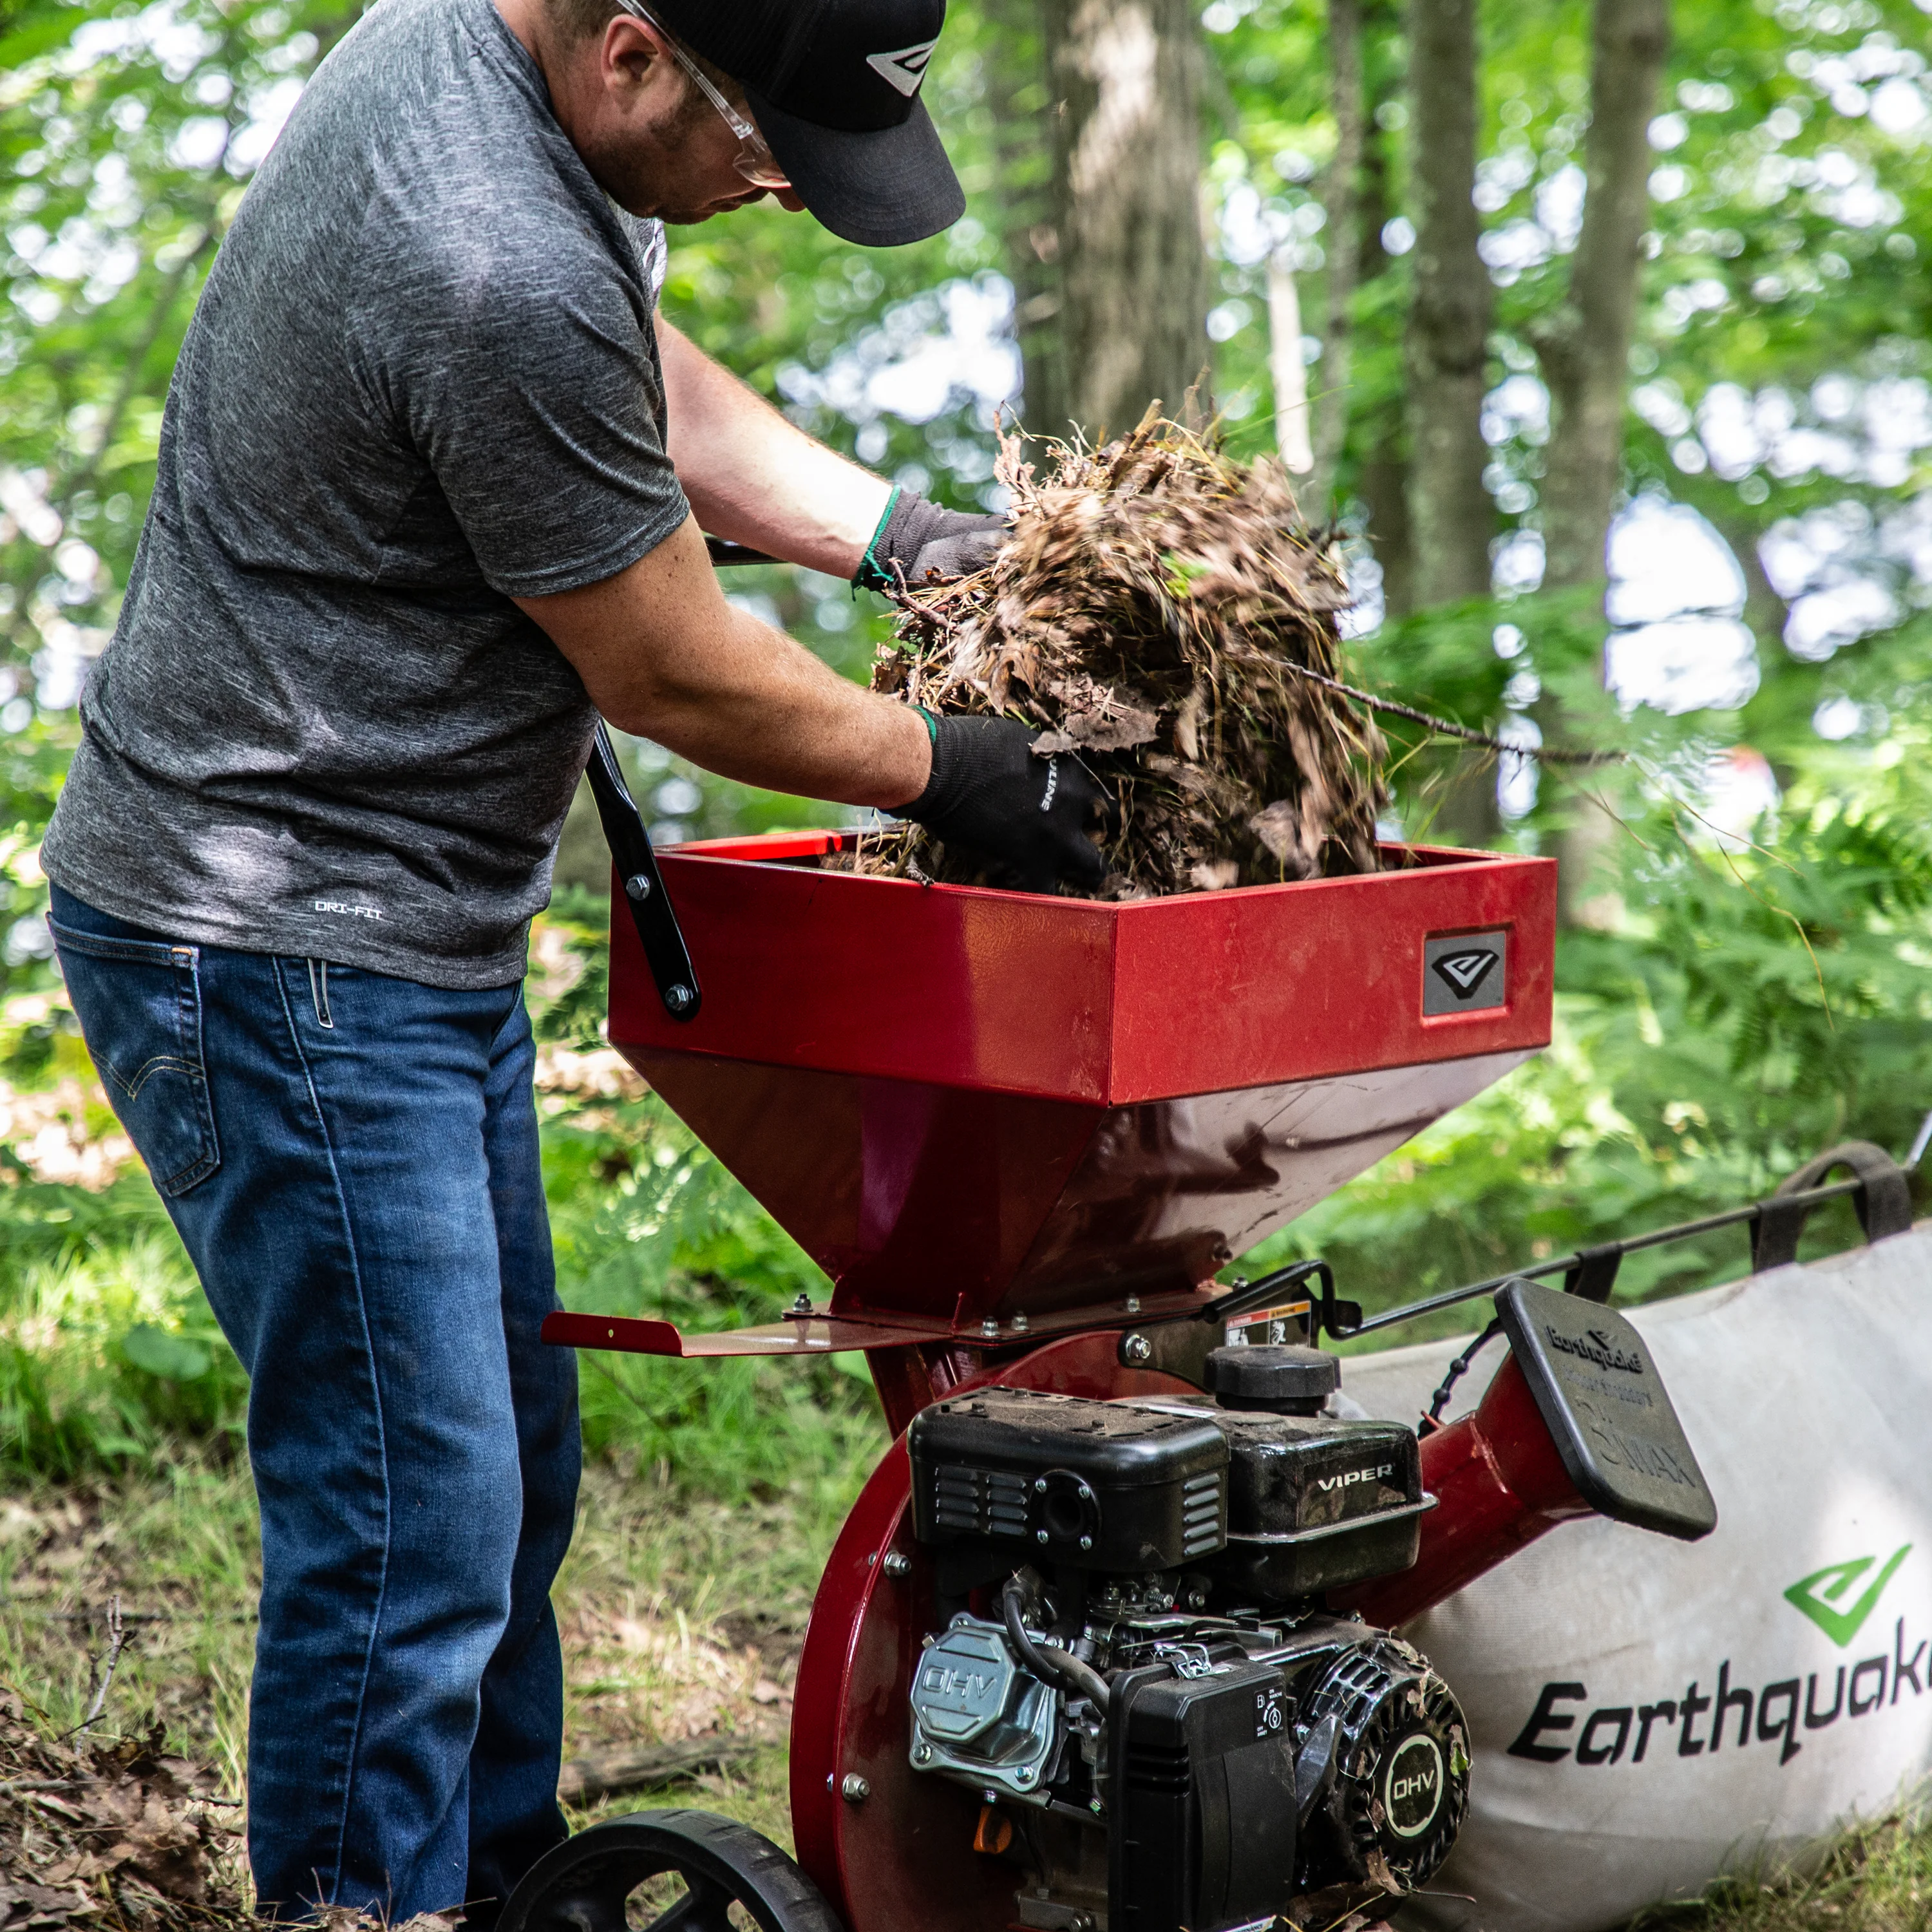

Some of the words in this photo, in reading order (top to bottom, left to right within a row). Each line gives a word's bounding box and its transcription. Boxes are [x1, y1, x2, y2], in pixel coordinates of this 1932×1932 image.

[1041, 759, 1057, 811] ULINE
[315, 900, 383, 920] DRI-FIT
[1318, 1463, 1393, 1491] VIPER
[922, 1665, 997, 1698] OHV
[1508, 1616, 1932, 1766] Earthquak
[1394, 1769, 1435, 1801] OHV
